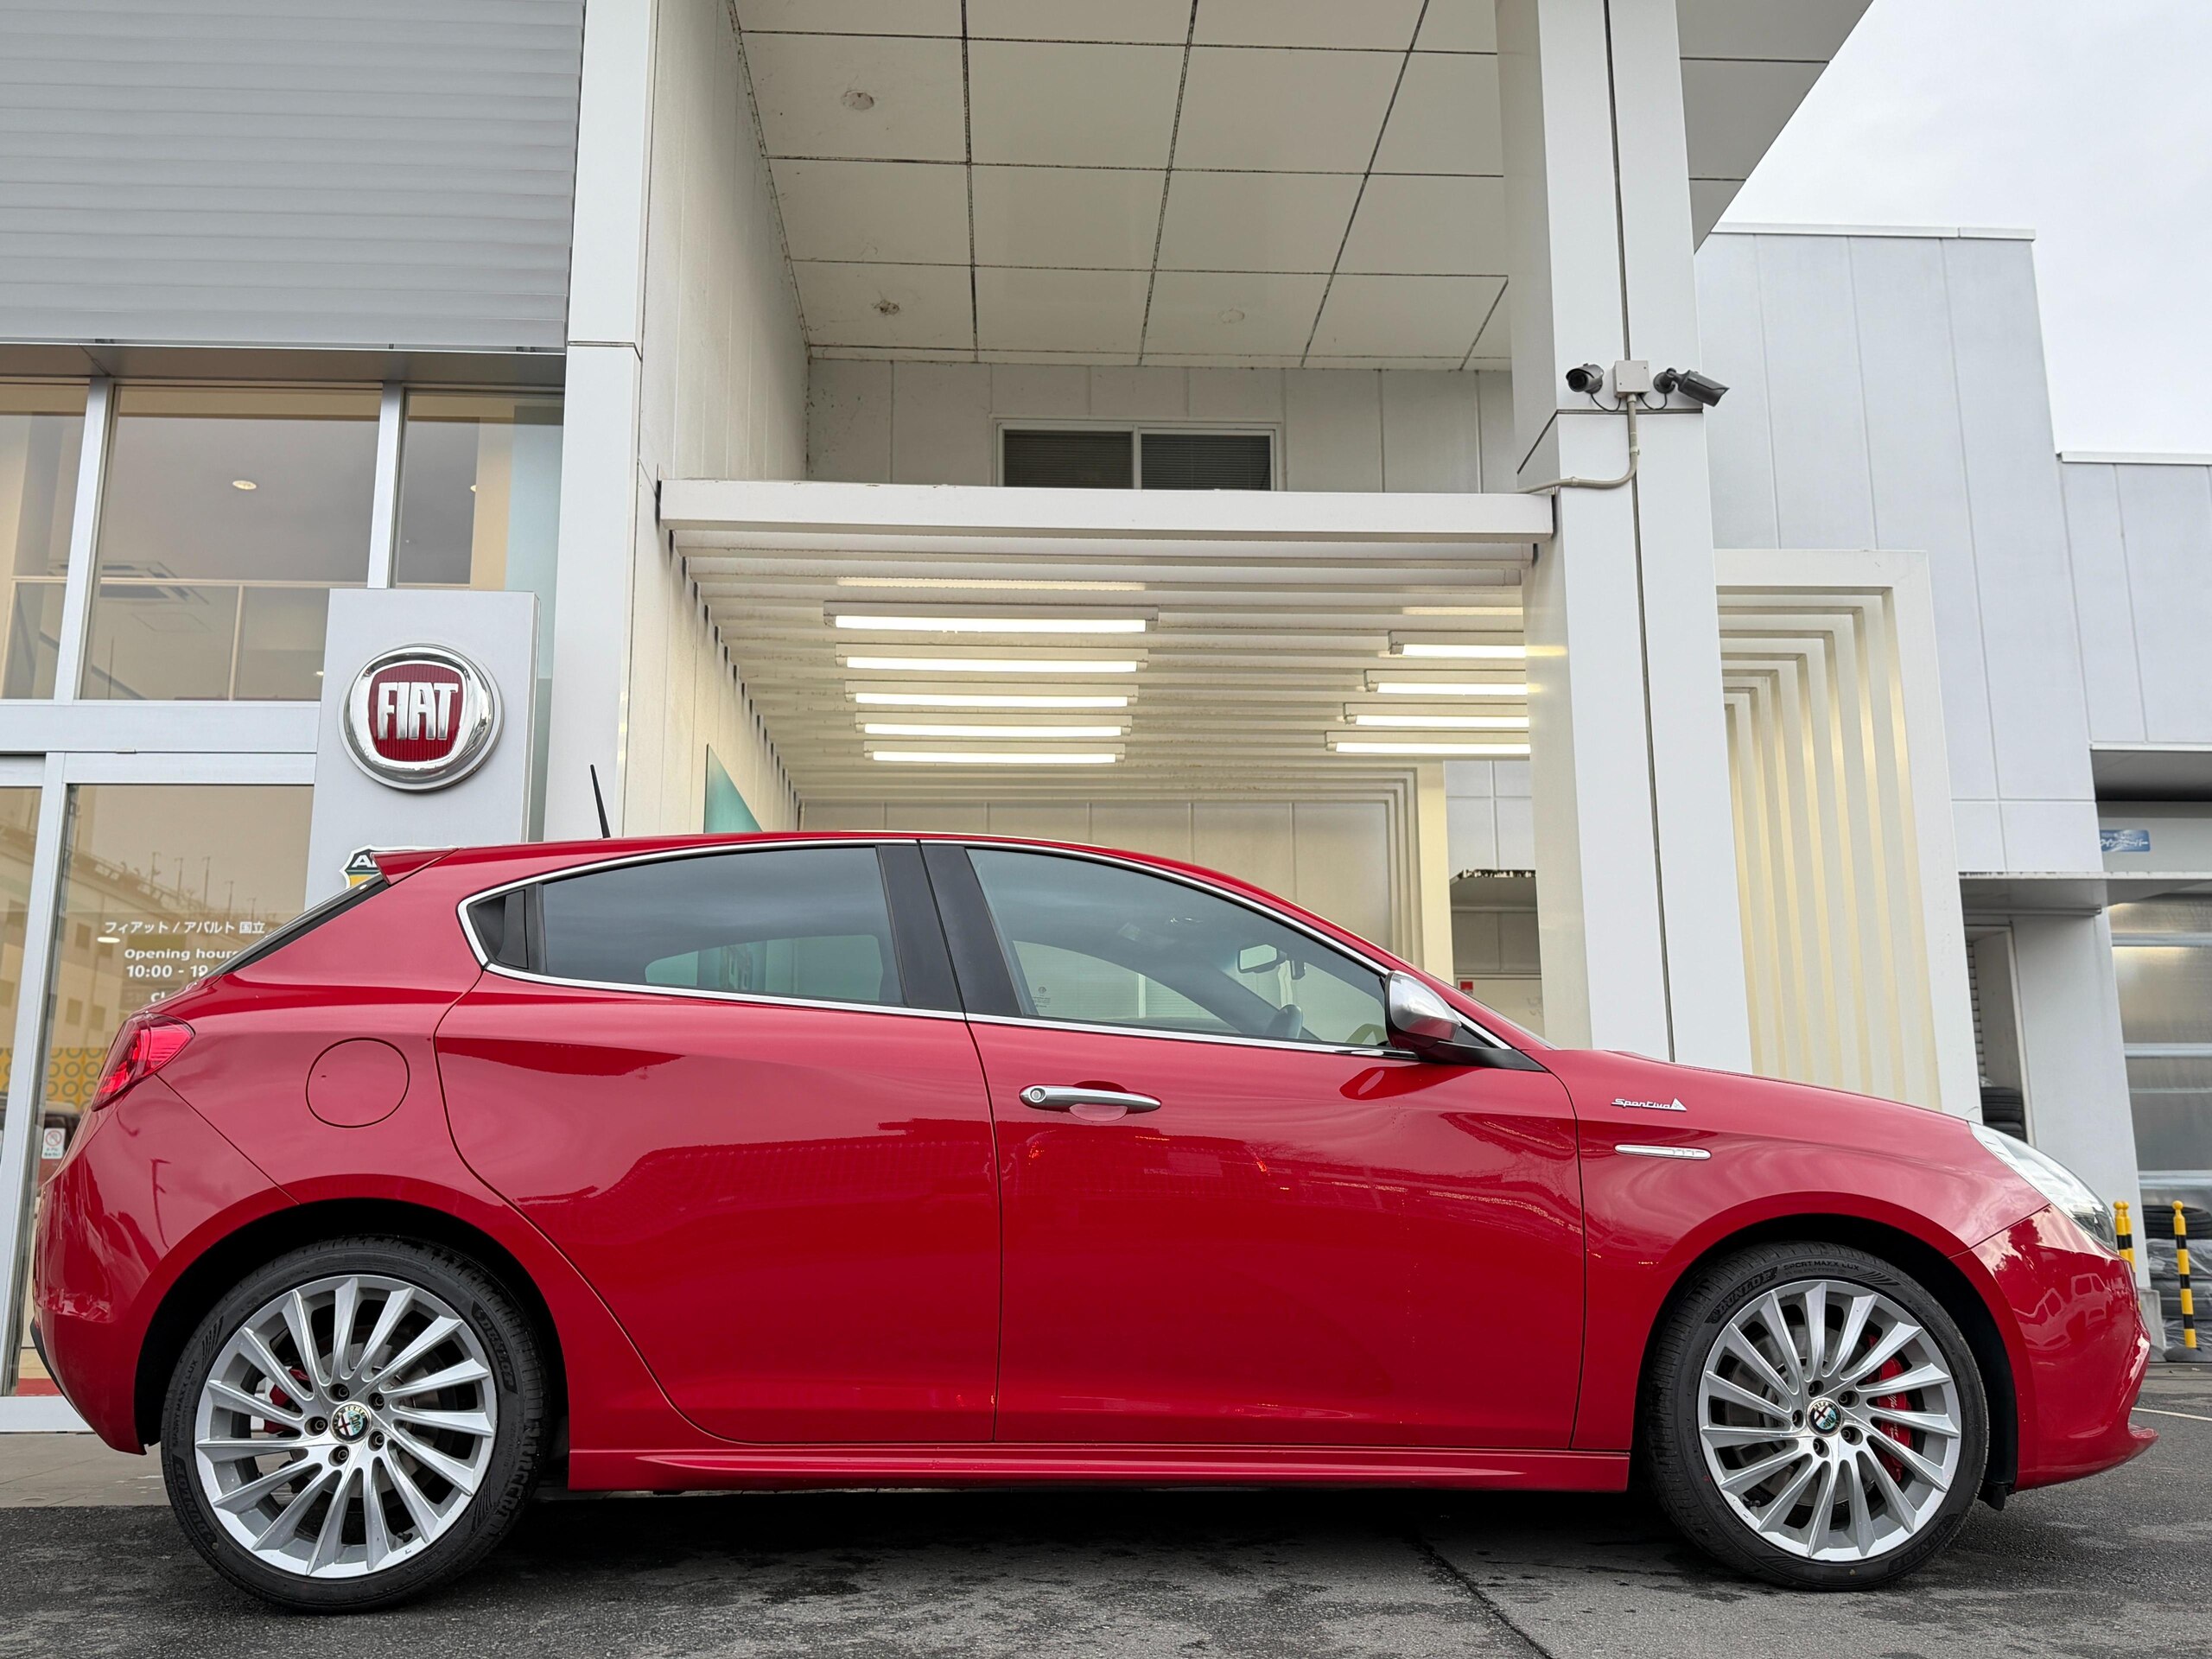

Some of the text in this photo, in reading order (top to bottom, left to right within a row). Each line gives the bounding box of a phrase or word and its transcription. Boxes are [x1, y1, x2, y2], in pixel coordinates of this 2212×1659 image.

[378, 682, 459, 741] FIAT
[351, 855, 378, 868] A
[105, 921, 168, 934] フィアット
[184, 921, 235, 934] アバルト
[239, 921, 265, 934] 国立
[124, 948, 191, 961] Opening
[127, 964, 173, 978] 10:00
[1611, 1098, 1672, 1109] Sportiva
[1841, 1262, 1860, 1272] LUX
[185, 1359, 199, 1380] LUX
